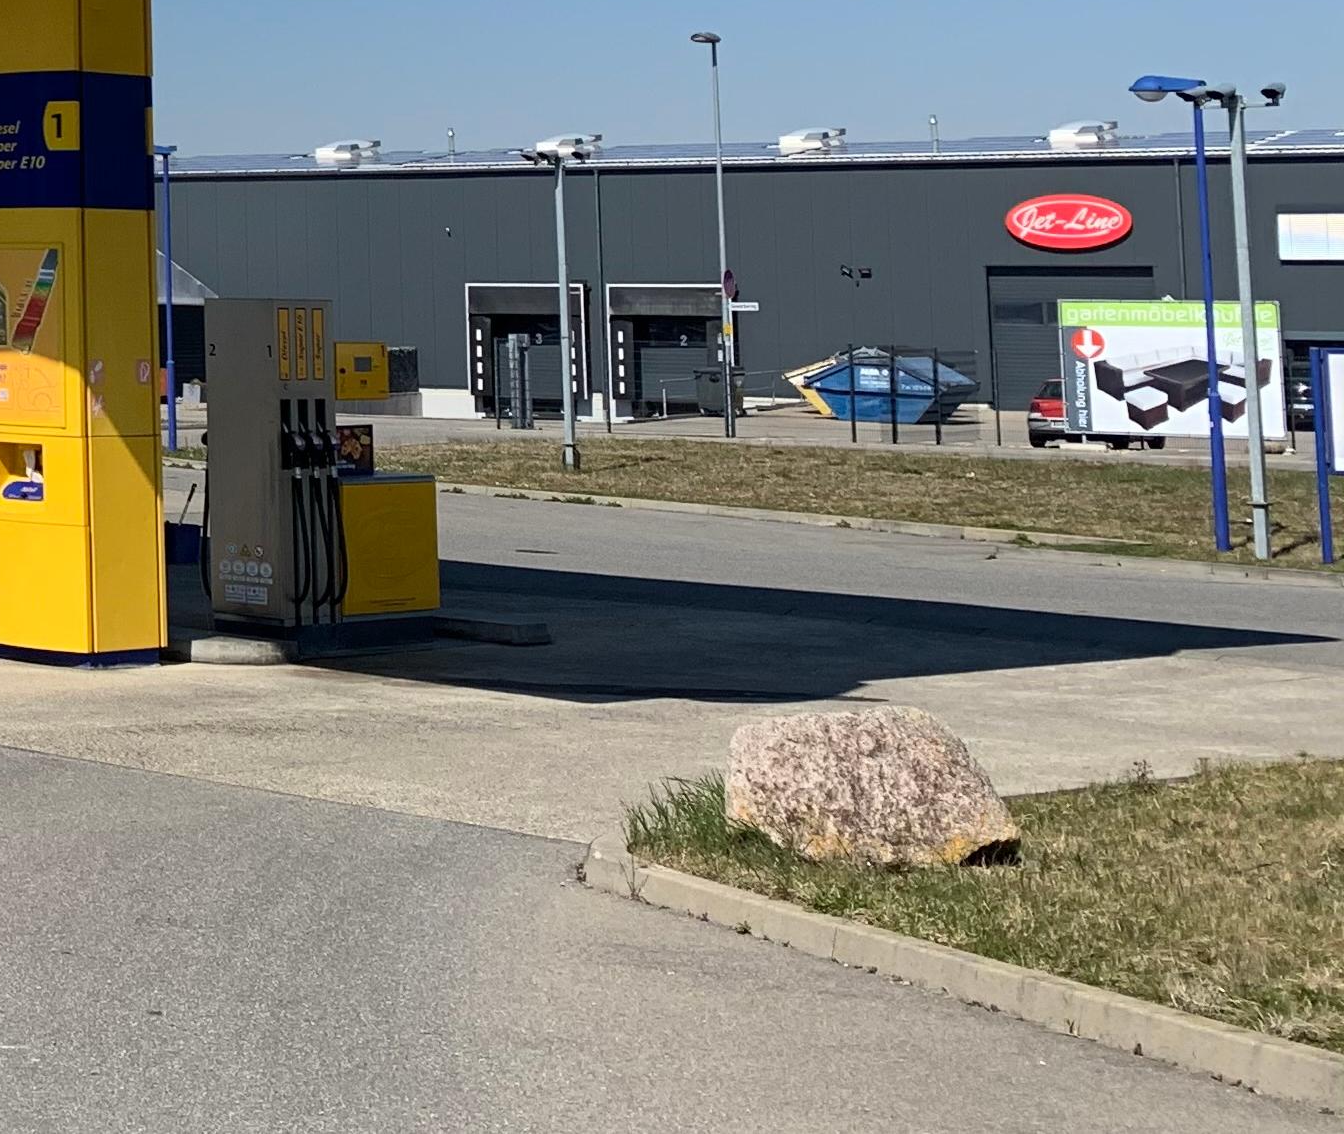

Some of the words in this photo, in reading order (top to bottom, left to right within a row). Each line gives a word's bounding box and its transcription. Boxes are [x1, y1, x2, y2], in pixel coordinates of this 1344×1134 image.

[51, 113, 63, 139] 1
[19, 155, 46, 170] E10
[1020, 207, 1121, 236] Jet-Line
[535, 333, 543, 345] 3
[679, 334, 688, 346] 2
[209, 343, 216, 357] 2
[266, 345, 273, 358] 1
[1075, 360, 1087, 408] Abholung
[1078, 409, 1088, 428] hier
